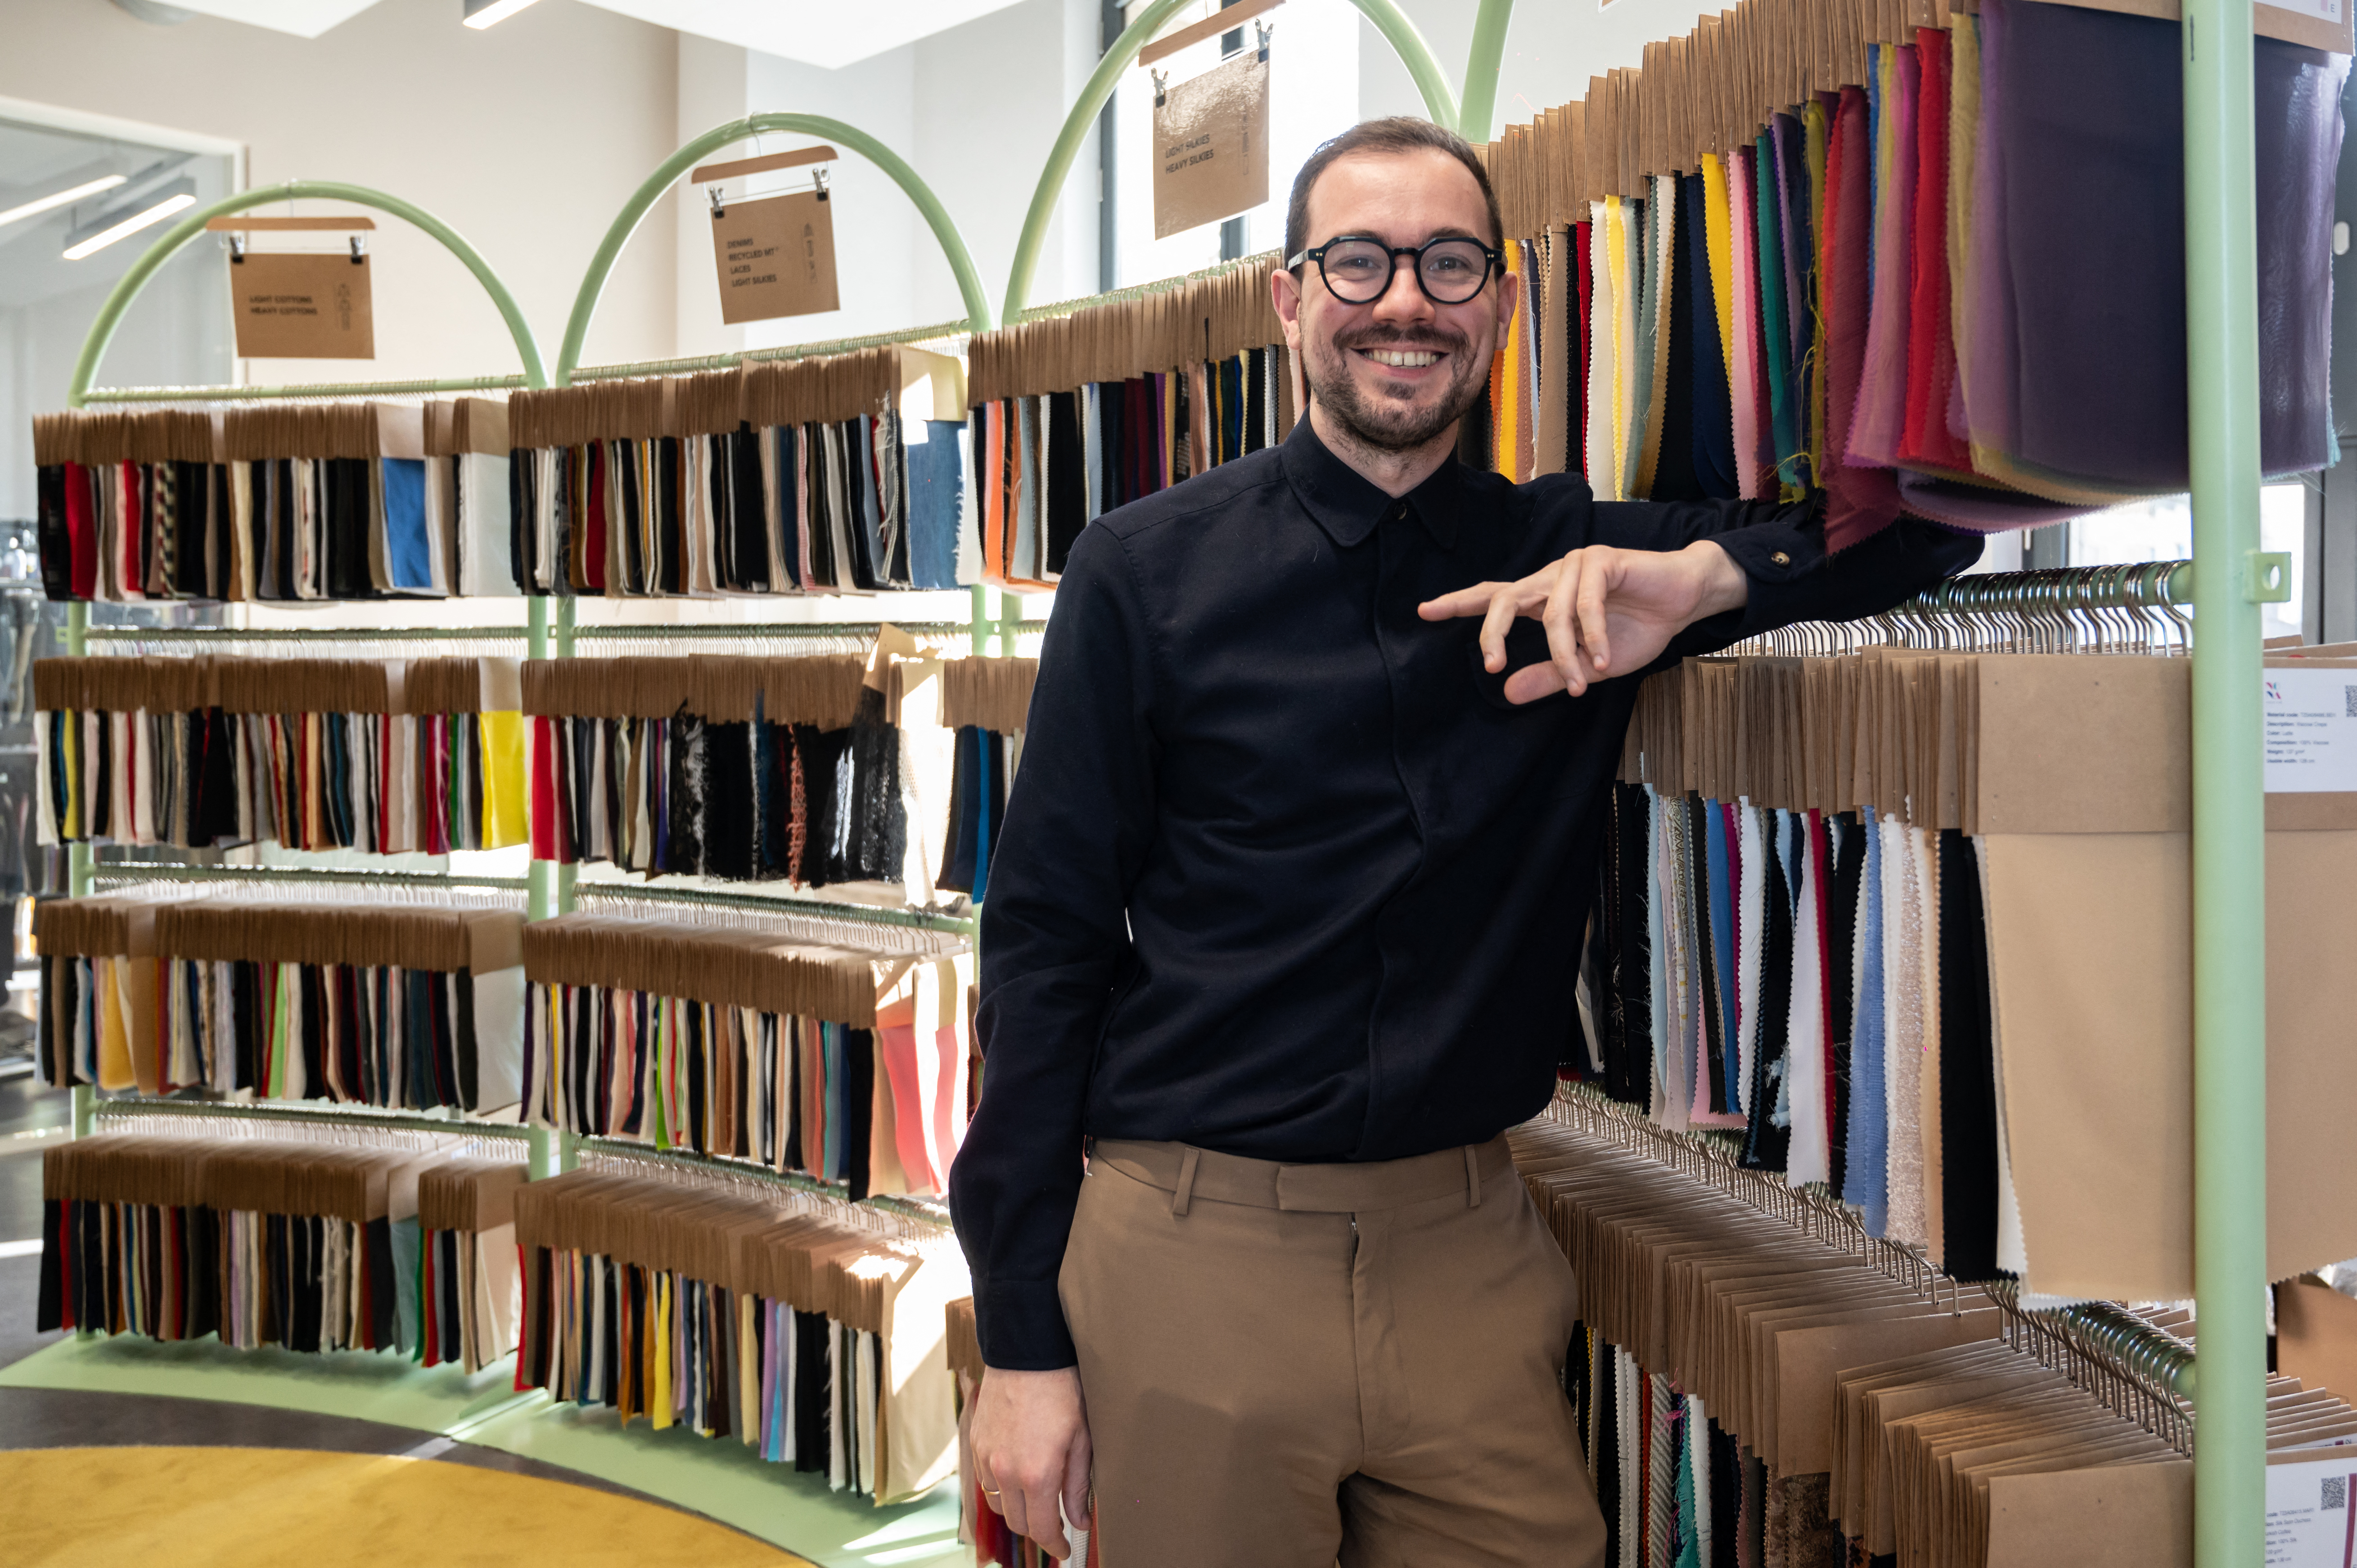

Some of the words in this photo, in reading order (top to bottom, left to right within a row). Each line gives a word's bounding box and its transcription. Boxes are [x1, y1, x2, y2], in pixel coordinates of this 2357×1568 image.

[1165, 143, 1185, 158] LIGHT
[1185, 134, 1210, 151] SILKIES
[1166, 158, 1188, 175] HEAVY
[1189, 149, 1214, 166] SILKIES
[727, 238, 753, 249] DENIMS
[729, 250, 763, 261] RECYCLED
[730, 264, 751, 275] LACES
[732, 277, 751, 288] LIGHT
